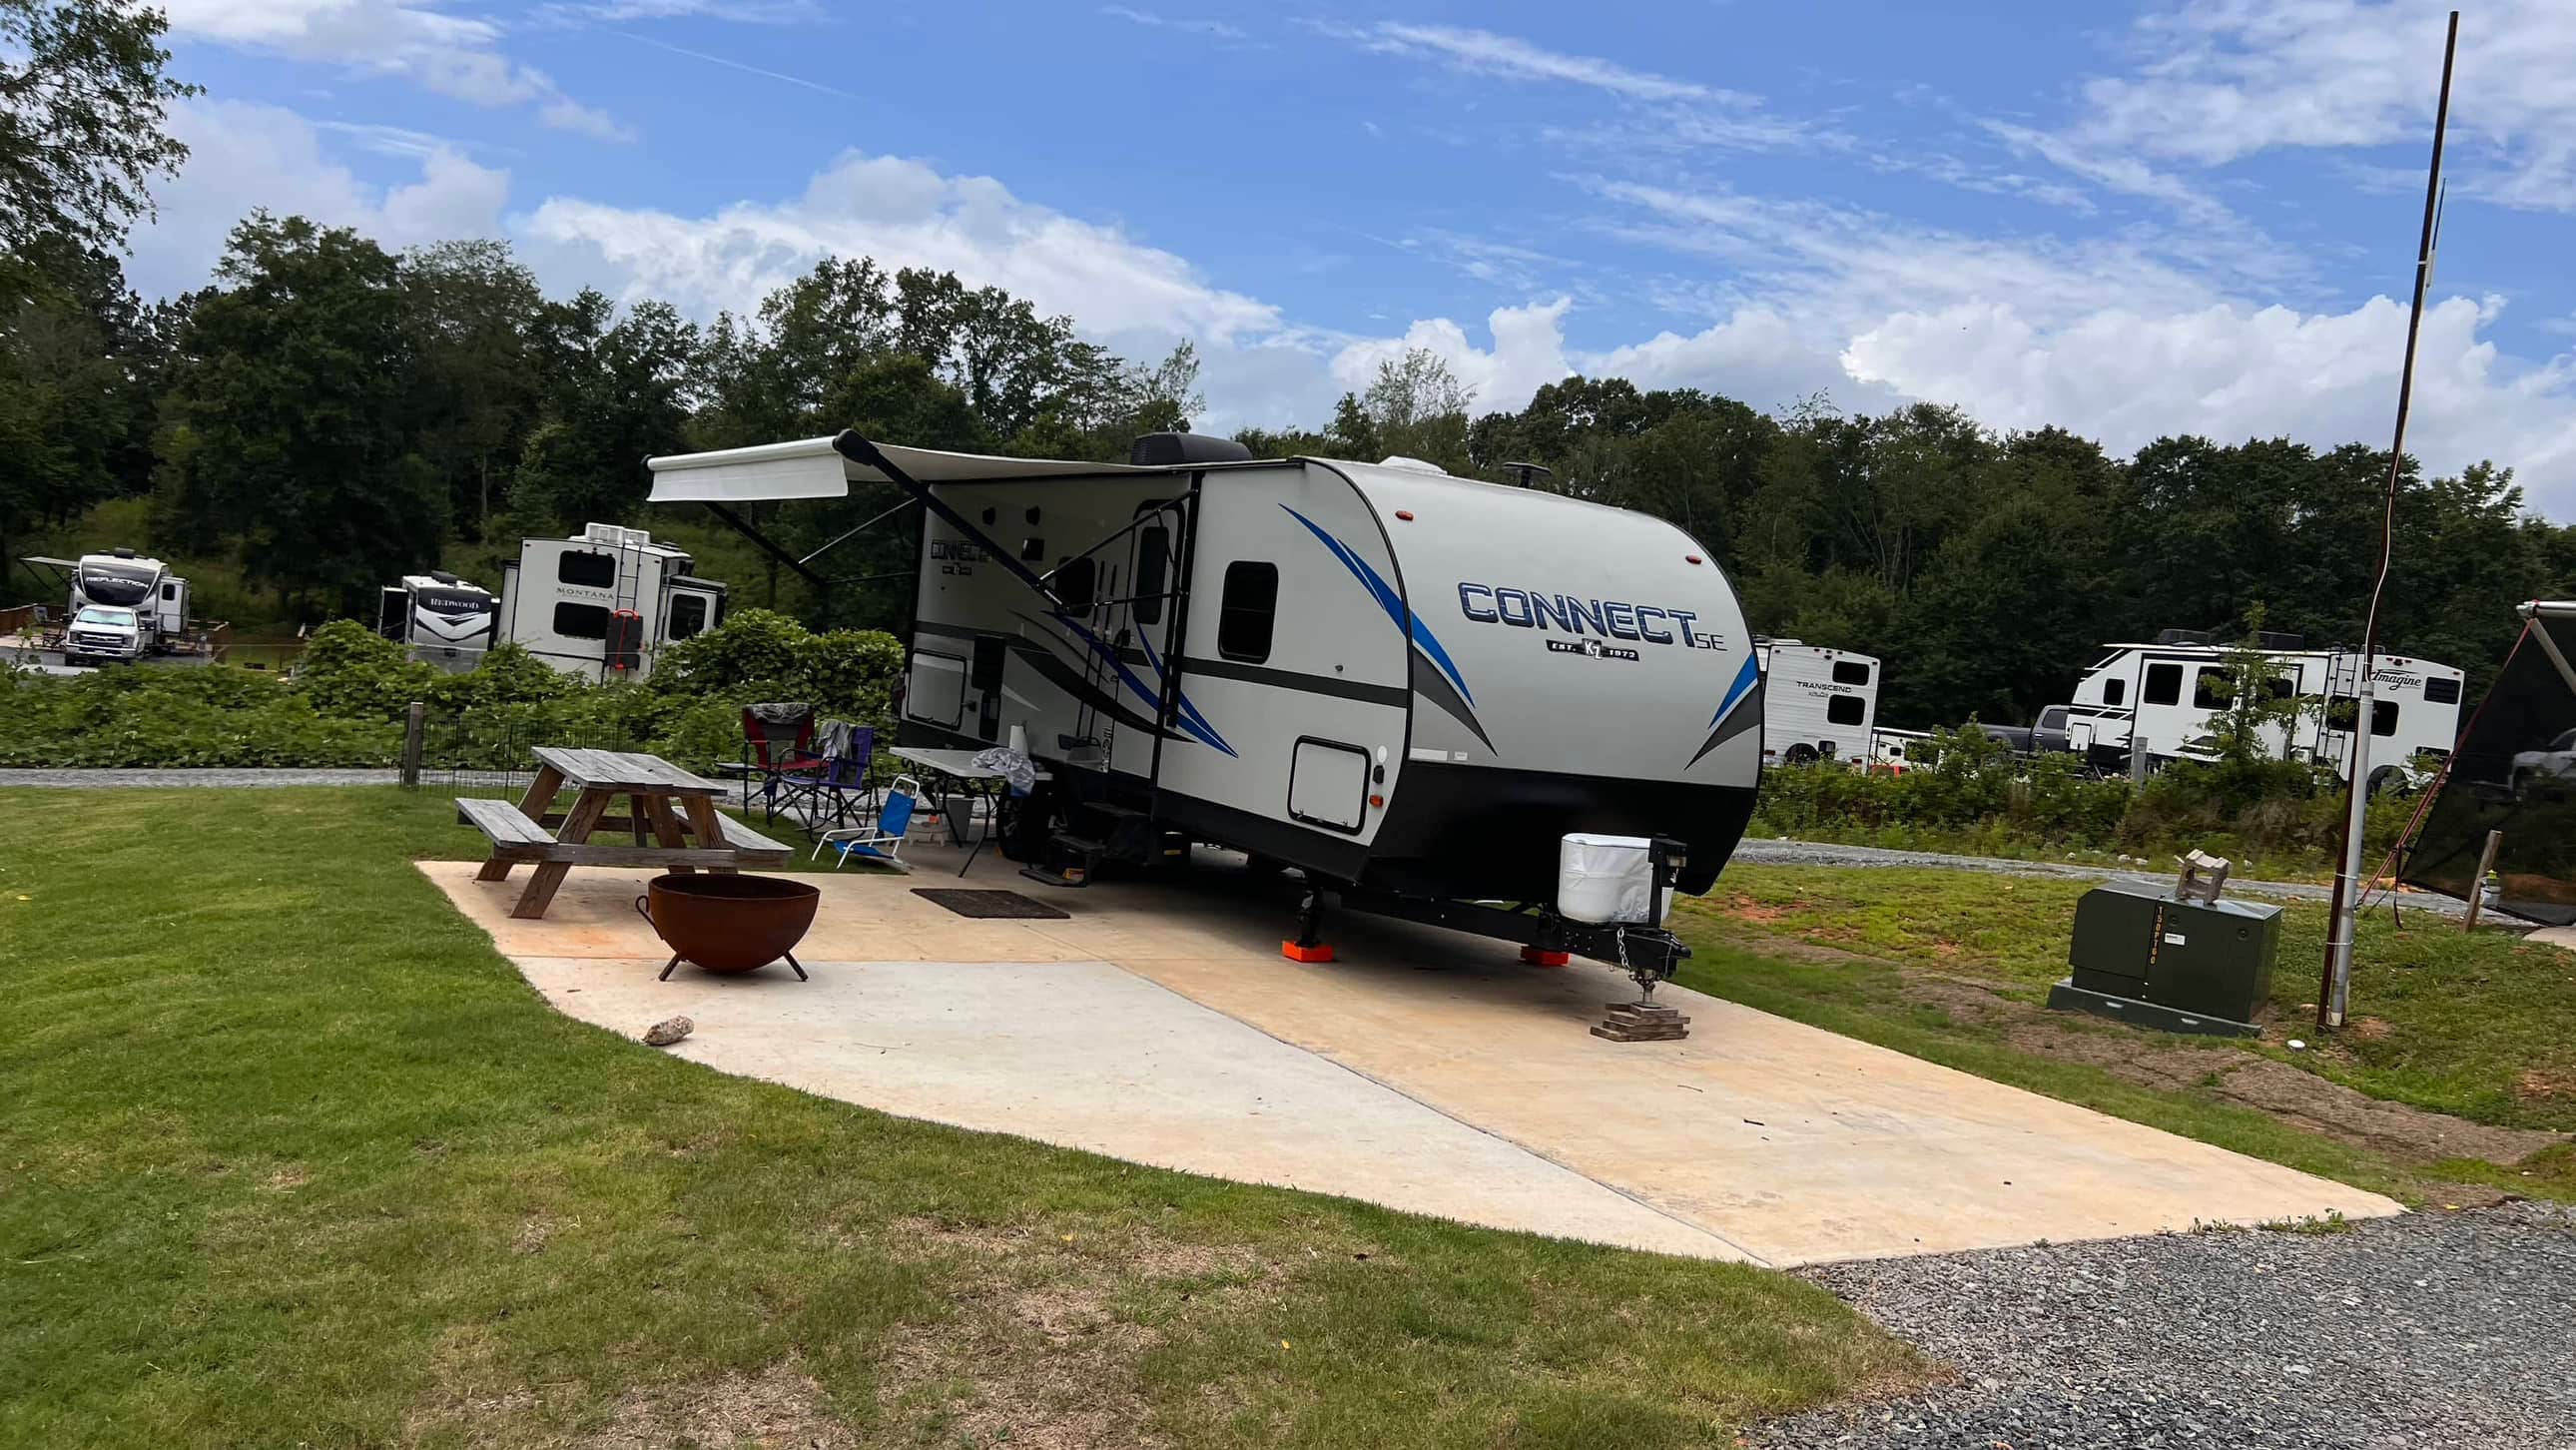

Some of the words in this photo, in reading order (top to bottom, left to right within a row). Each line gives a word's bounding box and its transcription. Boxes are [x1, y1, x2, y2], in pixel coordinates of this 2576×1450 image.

[556, 587, 614, 600] MONTANA
[1458, 581, 1698, 648] CONNECT
[1694, 632, 1728, 651] SE
[1552, 642, 1577, 651] EST.
[1610, 649, 1636, 659] 1972
[1796, 680, 1852, 693] TRANSCEND
[2370, 669, 2421, 690] Imagine
